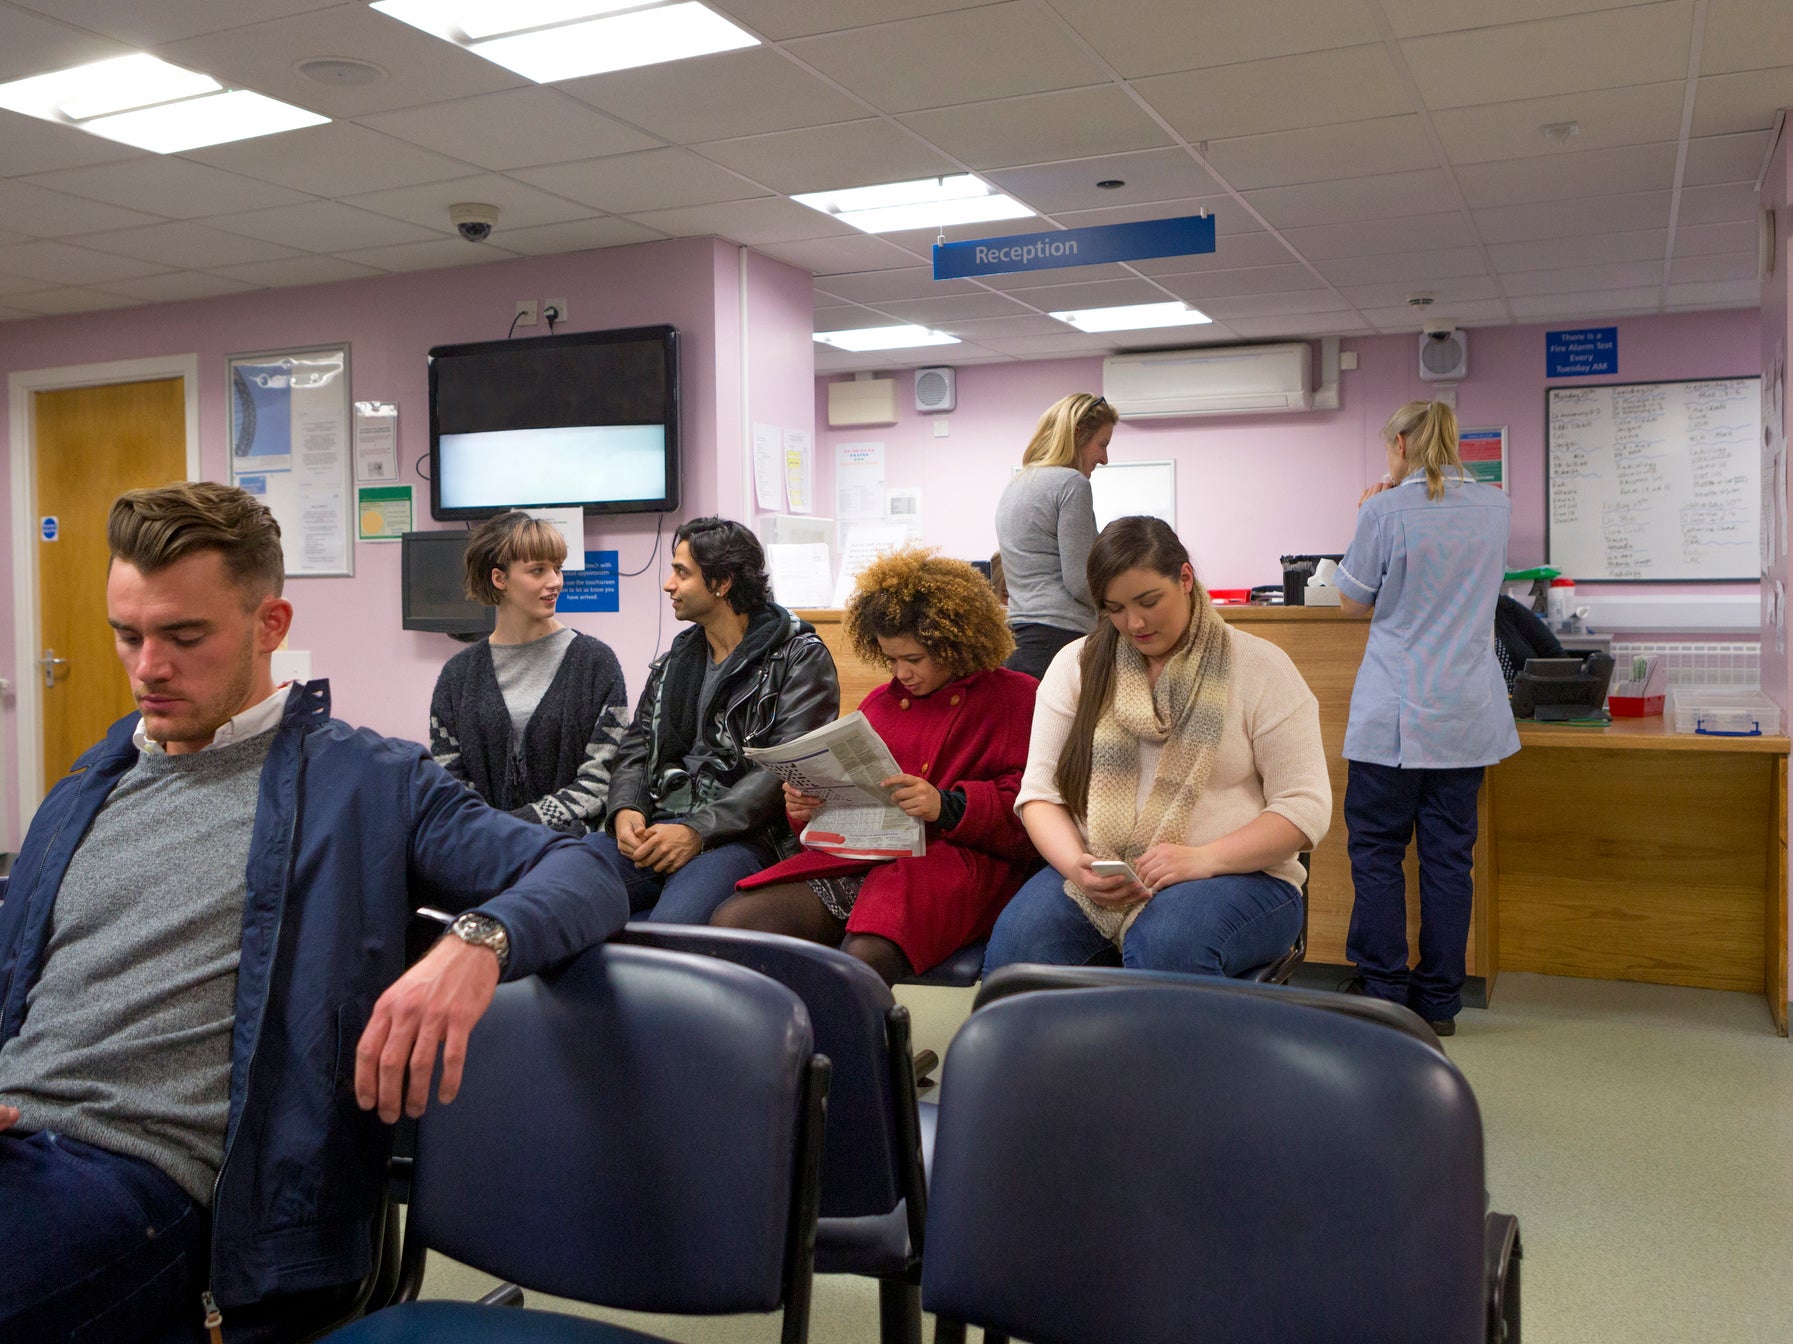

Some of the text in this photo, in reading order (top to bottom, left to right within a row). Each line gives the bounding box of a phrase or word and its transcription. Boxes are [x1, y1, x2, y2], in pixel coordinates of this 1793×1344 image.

[976, 239, 1078, 264] Reception
[1562, 333, 1585, 342] There
[1568, 343, 1594, 351] Alarm
[1570, 354, 1594, 362] Every
[1556, 362, 1608, 374] Tuesday AM
